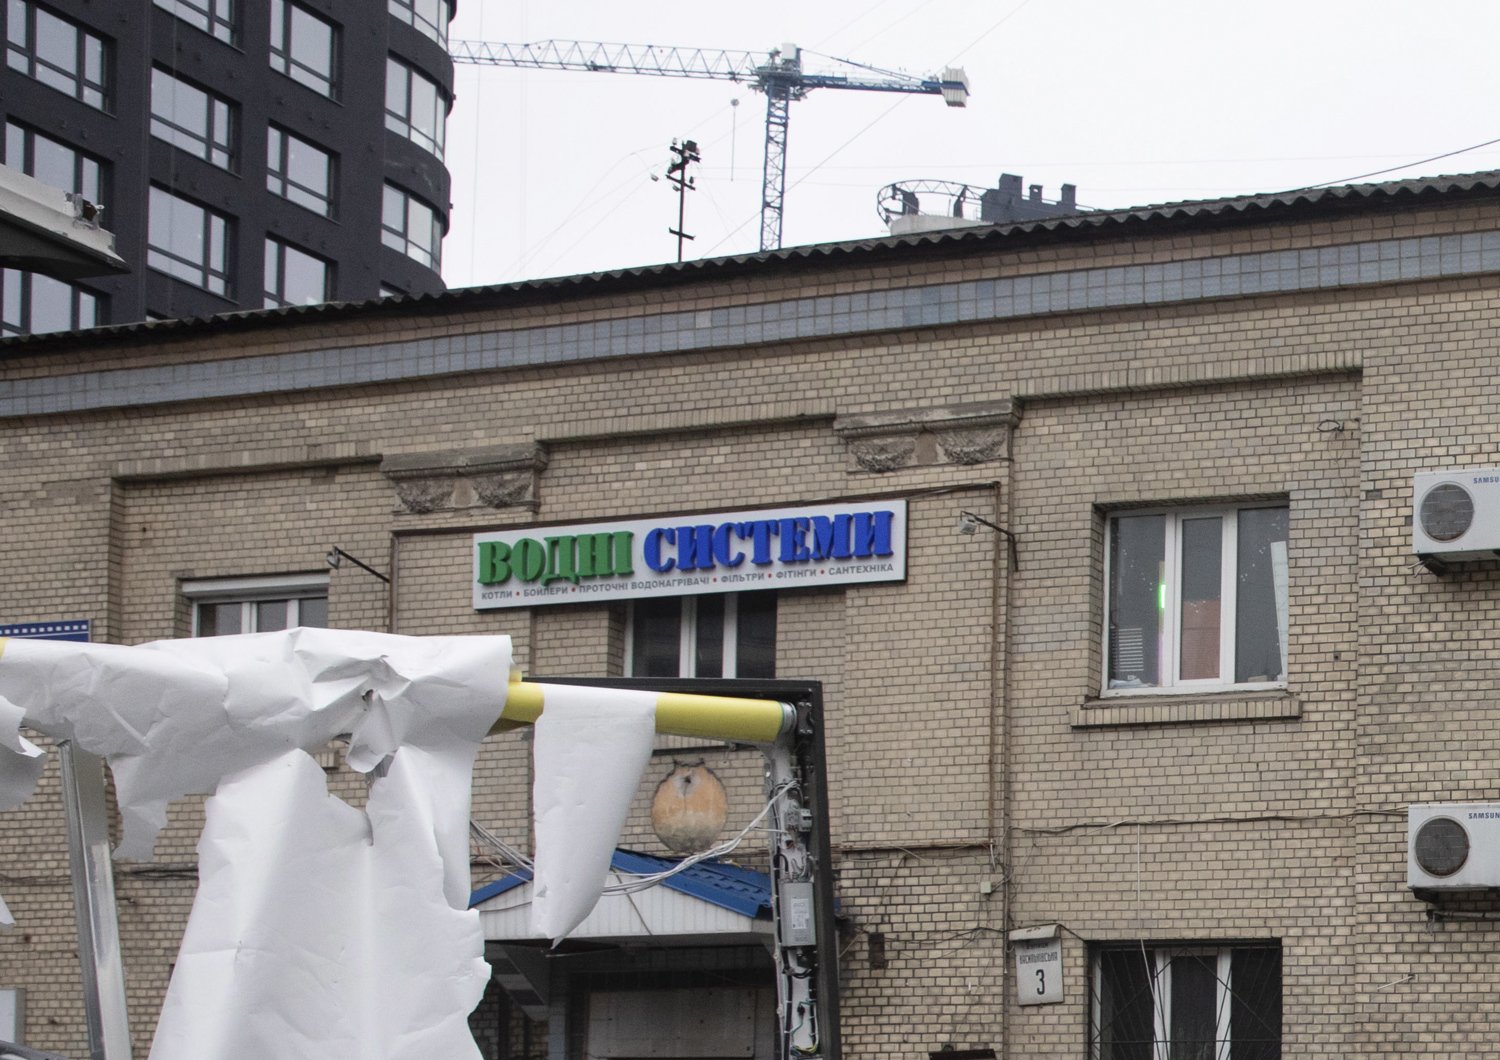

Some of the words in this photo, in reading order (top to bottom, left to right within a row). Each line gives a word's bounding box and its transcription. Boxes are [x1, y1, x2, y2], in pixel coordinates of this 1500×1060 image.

[478, 531, 635, 586] ВОДНІ
[643, 511, 895, 574] СИСТЕМИ
[481, 590, 513, 601] КОТЛИ
[523, 586, 568, 598] БОЙЛЕРИ
[579, 582, 628, 593] ПРОТОЧНІ
[631, 576, 710, 590] ВОДОНАГРІВАЧІ
[721, 572, 765, 583] ФІЛЬТРИ
[776, 568, 817, 580] ФІТІНГИ
[828, 563, 894, 576] САНТЕХНІКА
[1036, 969, 1045, 995] 3
